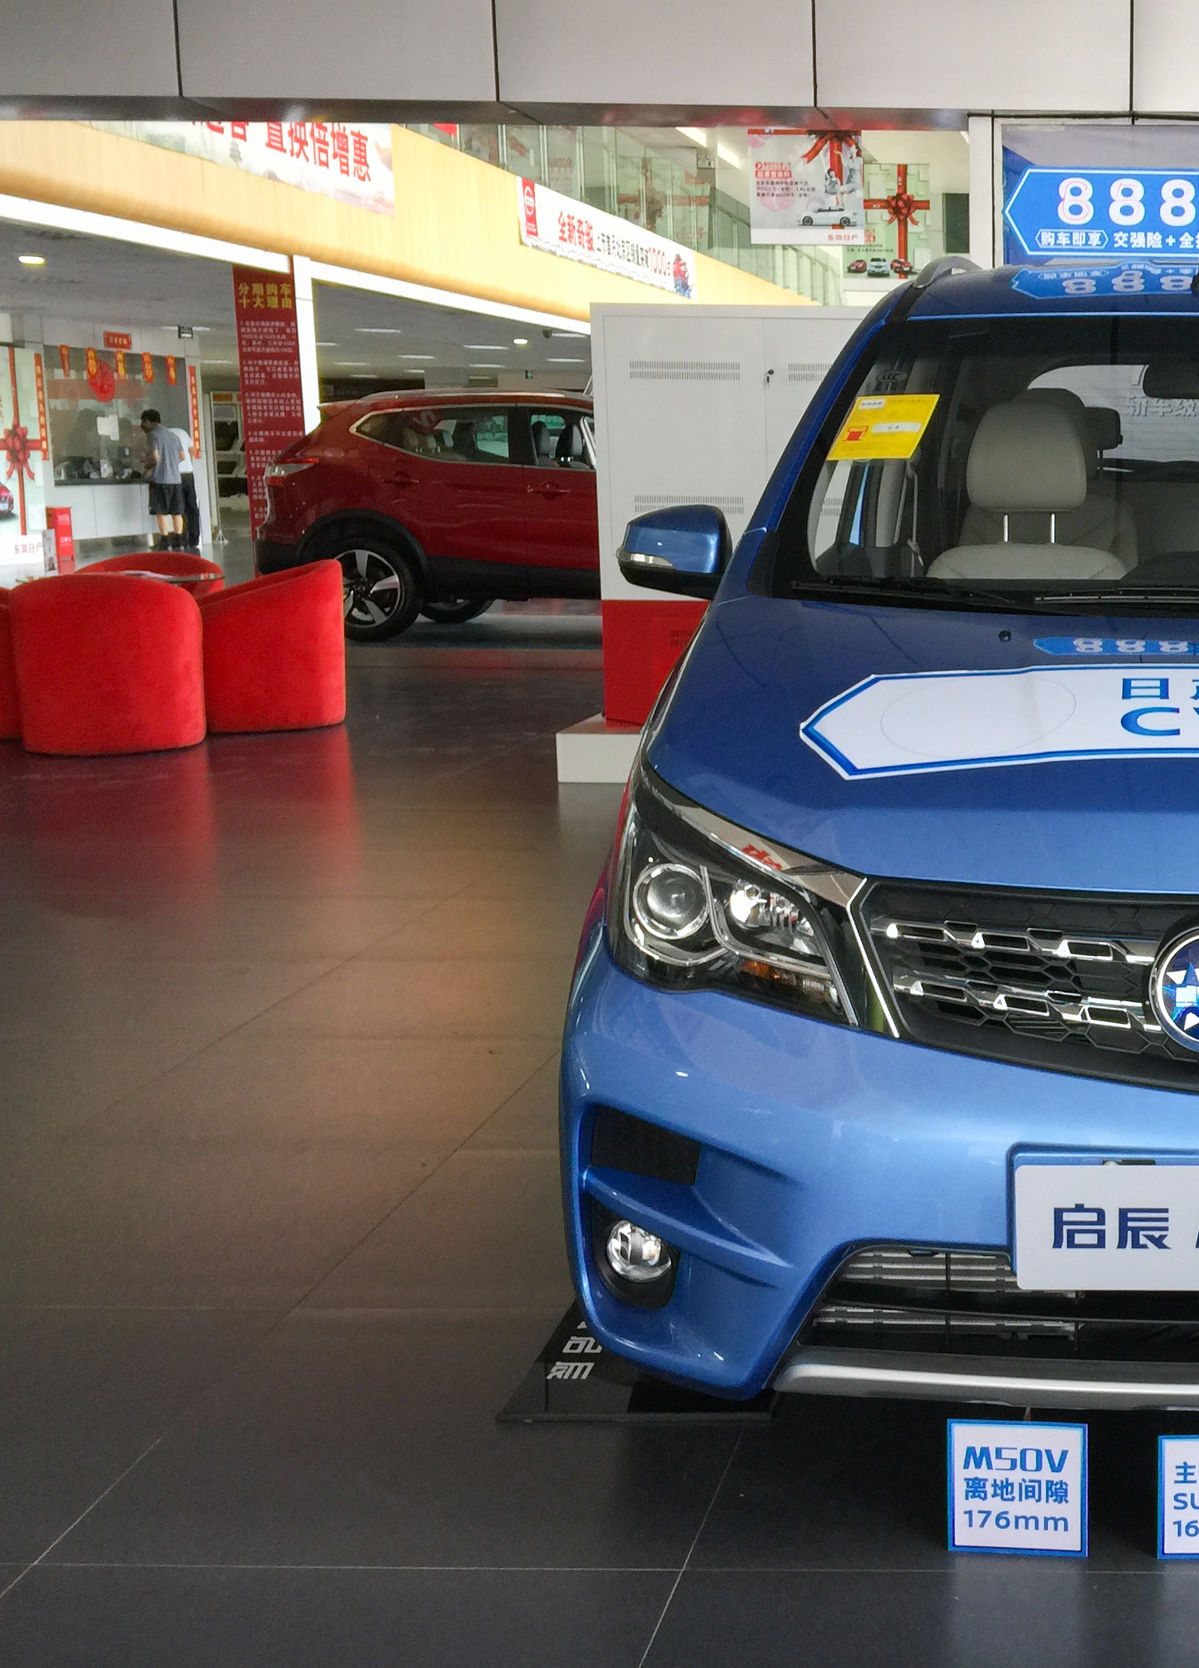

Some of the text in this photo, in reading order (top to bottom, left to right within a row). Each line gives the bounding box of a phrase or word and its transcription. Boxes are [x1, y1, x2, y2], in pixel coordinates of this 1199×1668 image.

[1041, 231, 1102, 247] 购车即享
[1052, 1203, 1172, 1250] 启辰
[963, 1446, 1069, 1473] M50V
[963, 1477, 1069, 1504] 离地间隙
[964, 1510, 1069, 1531] 176mm
